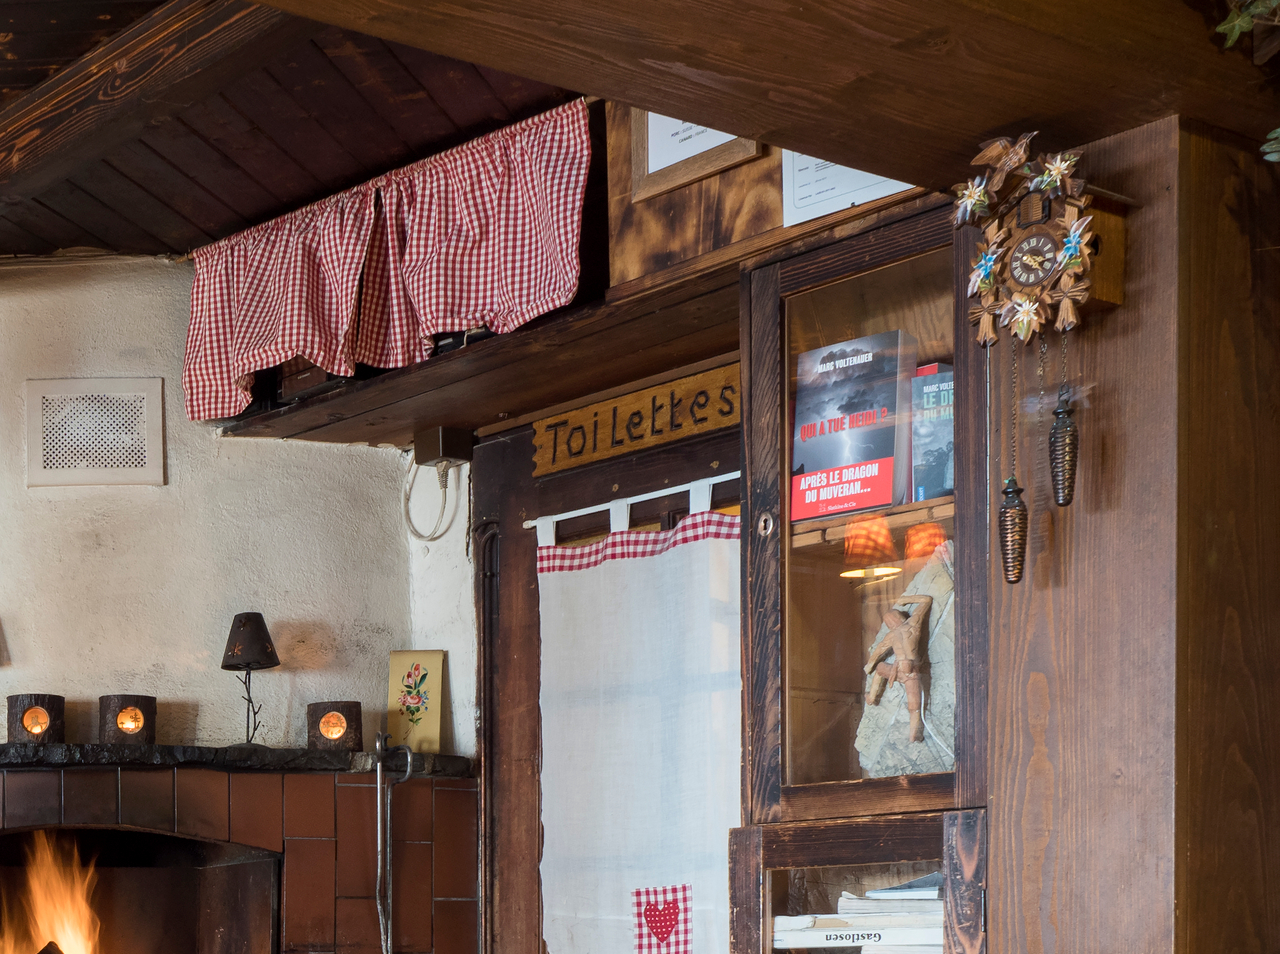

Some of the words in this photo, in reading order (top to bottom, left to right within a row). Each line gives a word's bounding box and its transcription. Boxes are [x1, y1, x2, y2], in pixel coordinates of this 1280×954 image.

[818, 361, 834, 373] MARC
[835, 352, 873, 369] VOLTENAUER
[923, 383, 939, 393] MARC
[923, 392, 937, 409] LE
[800, 422, 817, 442] QUI
[818, 420, 826, 436] A
[827, 413, 846, 434] TUÉ
[848, 409, 877, 429] HEIDI
[881, 407, 888, 422] ?
[800, 472, 827, 490] APRÈS
[829, 470, 840, 485] LE
[842, 463, 879, 482] DRAGON
[805, 489, 817, 504] DU
[819, 480, 871, 501] MUVERAN...
[825, 932, 882, 943] Gastlosen
